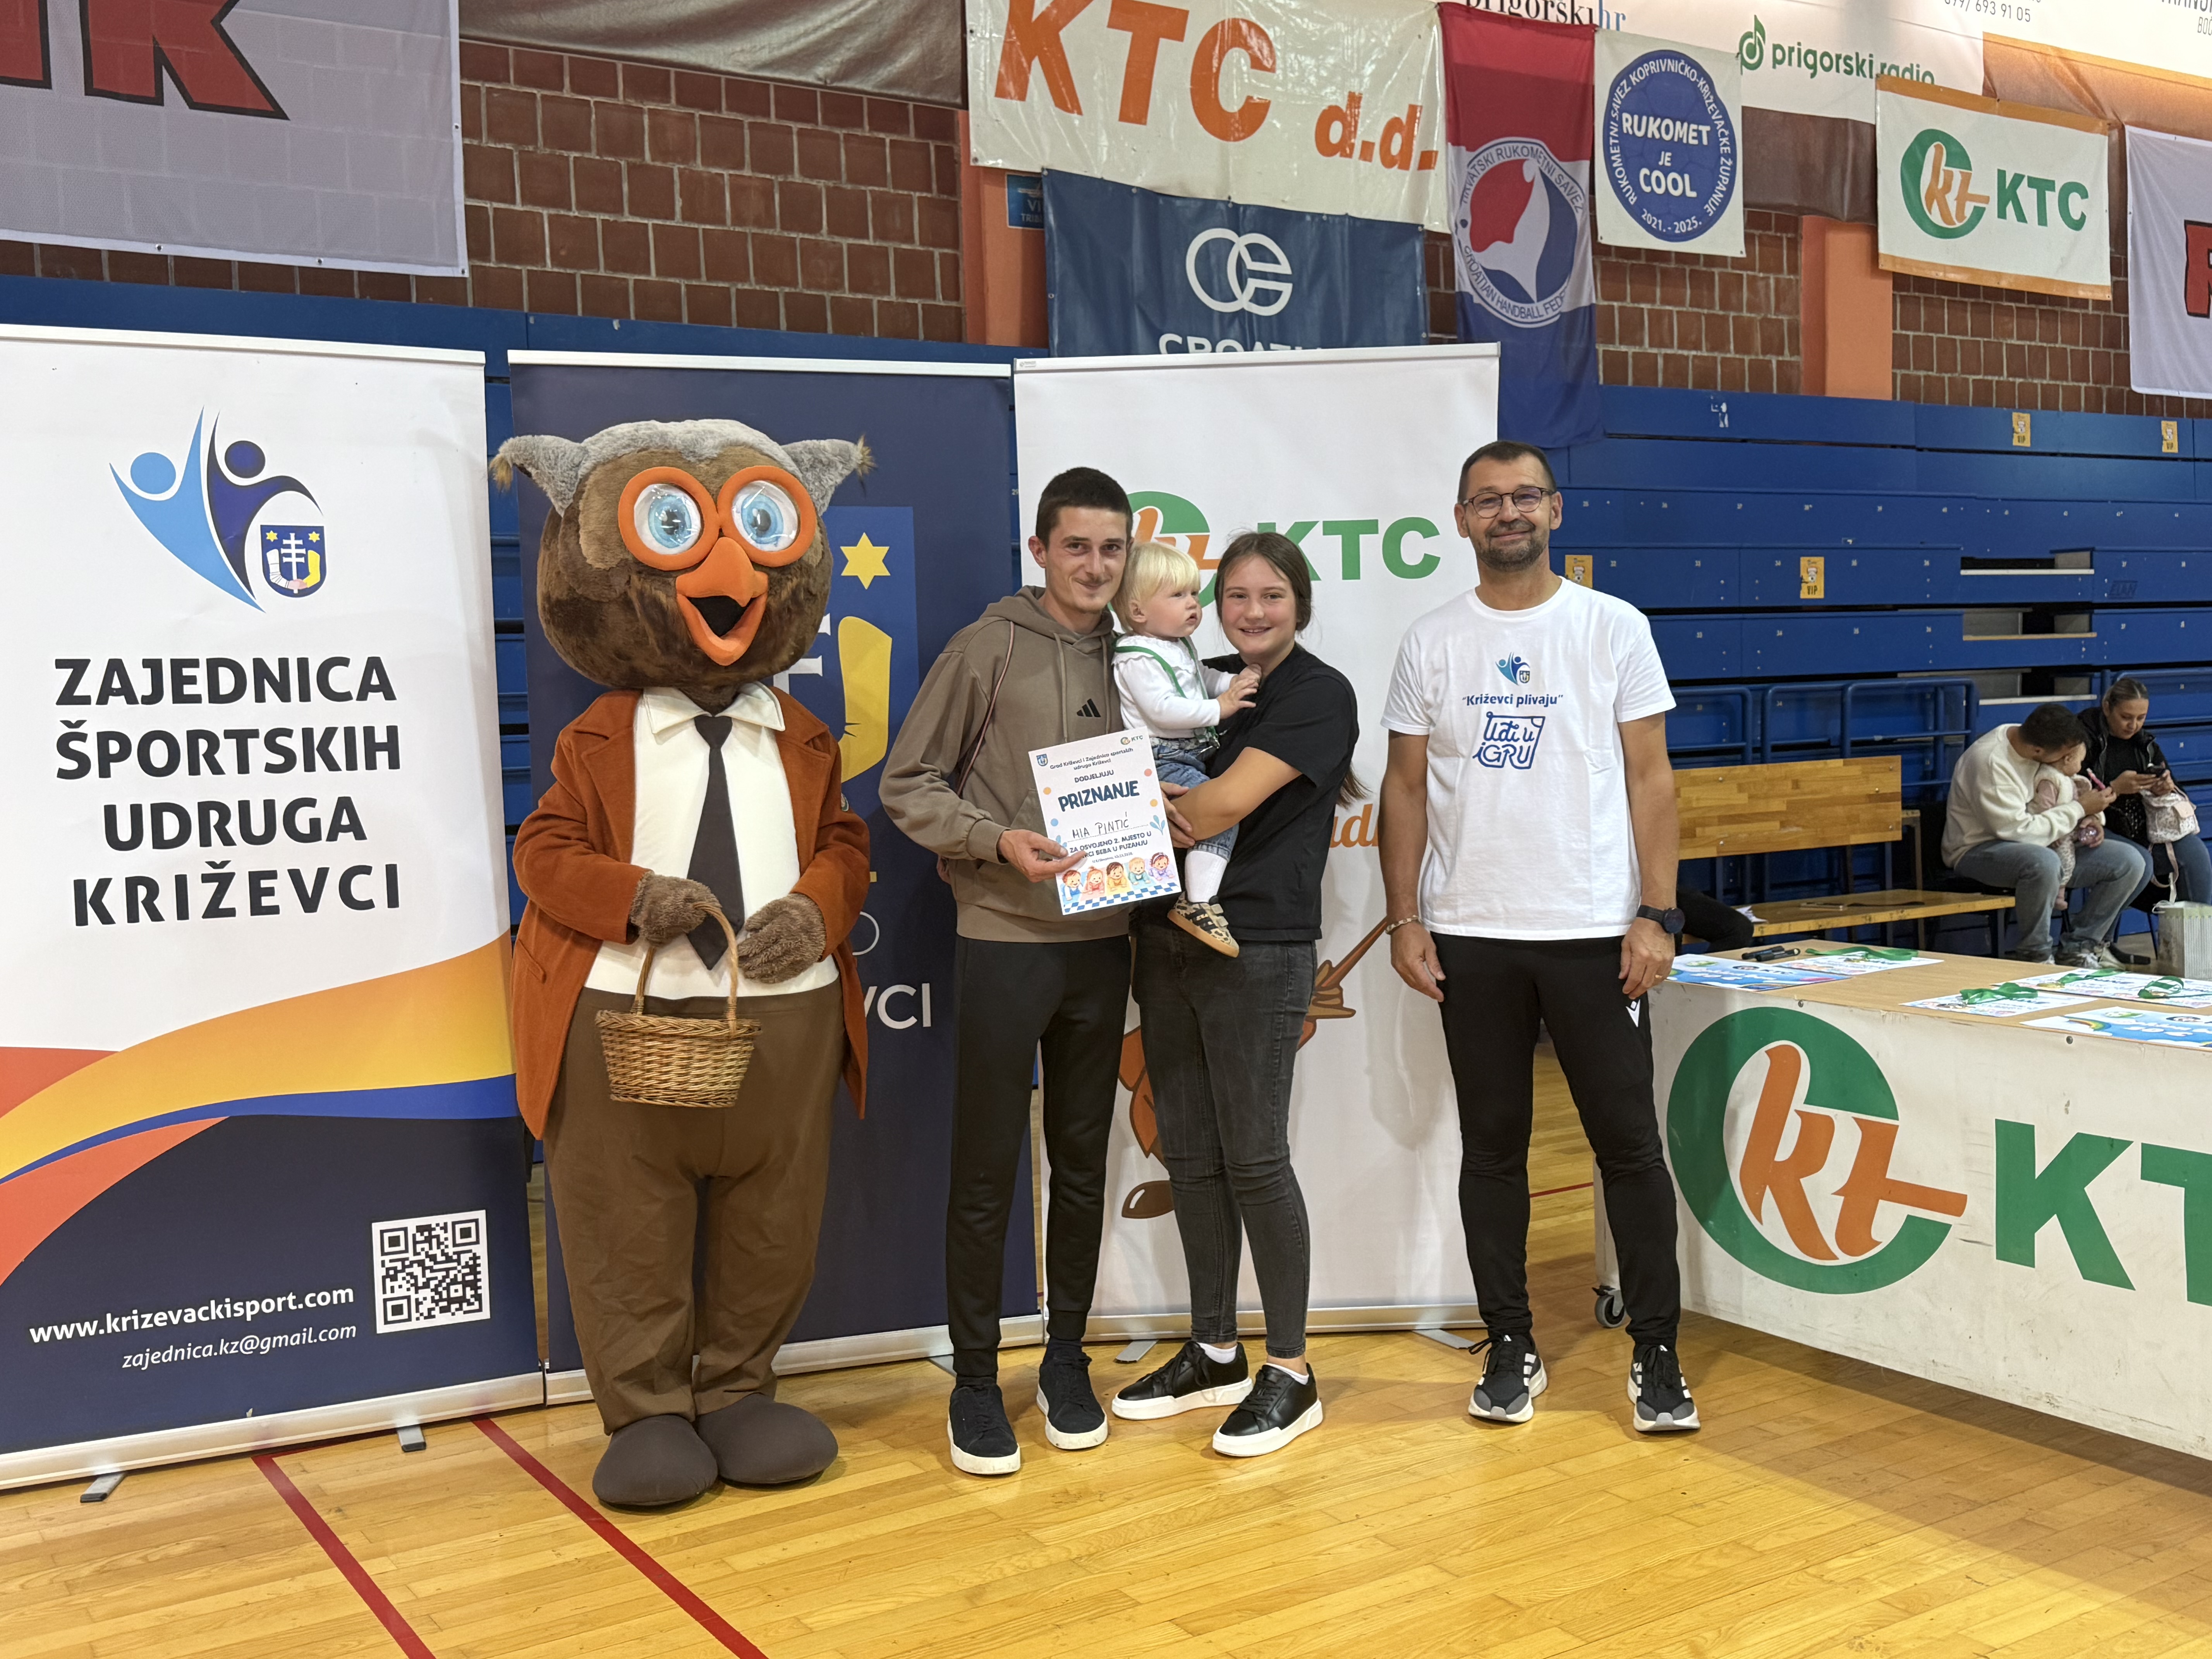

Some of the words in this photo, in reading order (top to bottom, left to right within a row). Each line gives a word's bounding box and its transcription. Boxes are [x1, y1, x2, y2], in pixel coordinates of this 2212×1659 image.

[1976, 0, 1996, 15] 693
[2001, 3, 2011, 19] 91
[2017, 7, 2030, 22] 05
[995, 0, 1276, 142] KTC
[1315, 92, 1438, 171] d.d.
[1611, 79, 1631, 120] SAVEZ
[1622, 113, 1711, 145] RUKOMET
[1498, 146, 1555, 174] RUKOMETNI
[1555, 174, 1584, 213] SAVEZ
[1609, 121, 1637, 204] RUKOMETNI
[1639, 168, 1697, 197] COOL
[1659, 151, 1672, 166] JE
[1704, 157, 1733, 216] ŽUPANIJE
[1997, 169, 2089, 230] KTC
[1496, 297, 1544, 319] HANDBALL
[1258, 517, 1441, 581] KTC
[1807, 585, 1818, 595] VIP
[55, 656, 397, 706] ZAJEDNICA
[56, 720, 400, 778] ŠPORTSKIH
[1058, 780, 1140, 812] PRIZNANJE
[1074, 770, 1114, 783] DODJELJUJU
[103, 796, 367, 851] UDRUGA
[1072, 827, 1090, 839] MIA
[1080, 839, 1113, 851] OSVOJENO
[1122, 833, 1145, 842] MJESTO
[74, 860, 399, 926] KRIŽEVCI
[29, 1285, 354, 1343] www.krizevackisport.com
[122, 1322, 357, 1370] zajednica.kz@gmail.com
